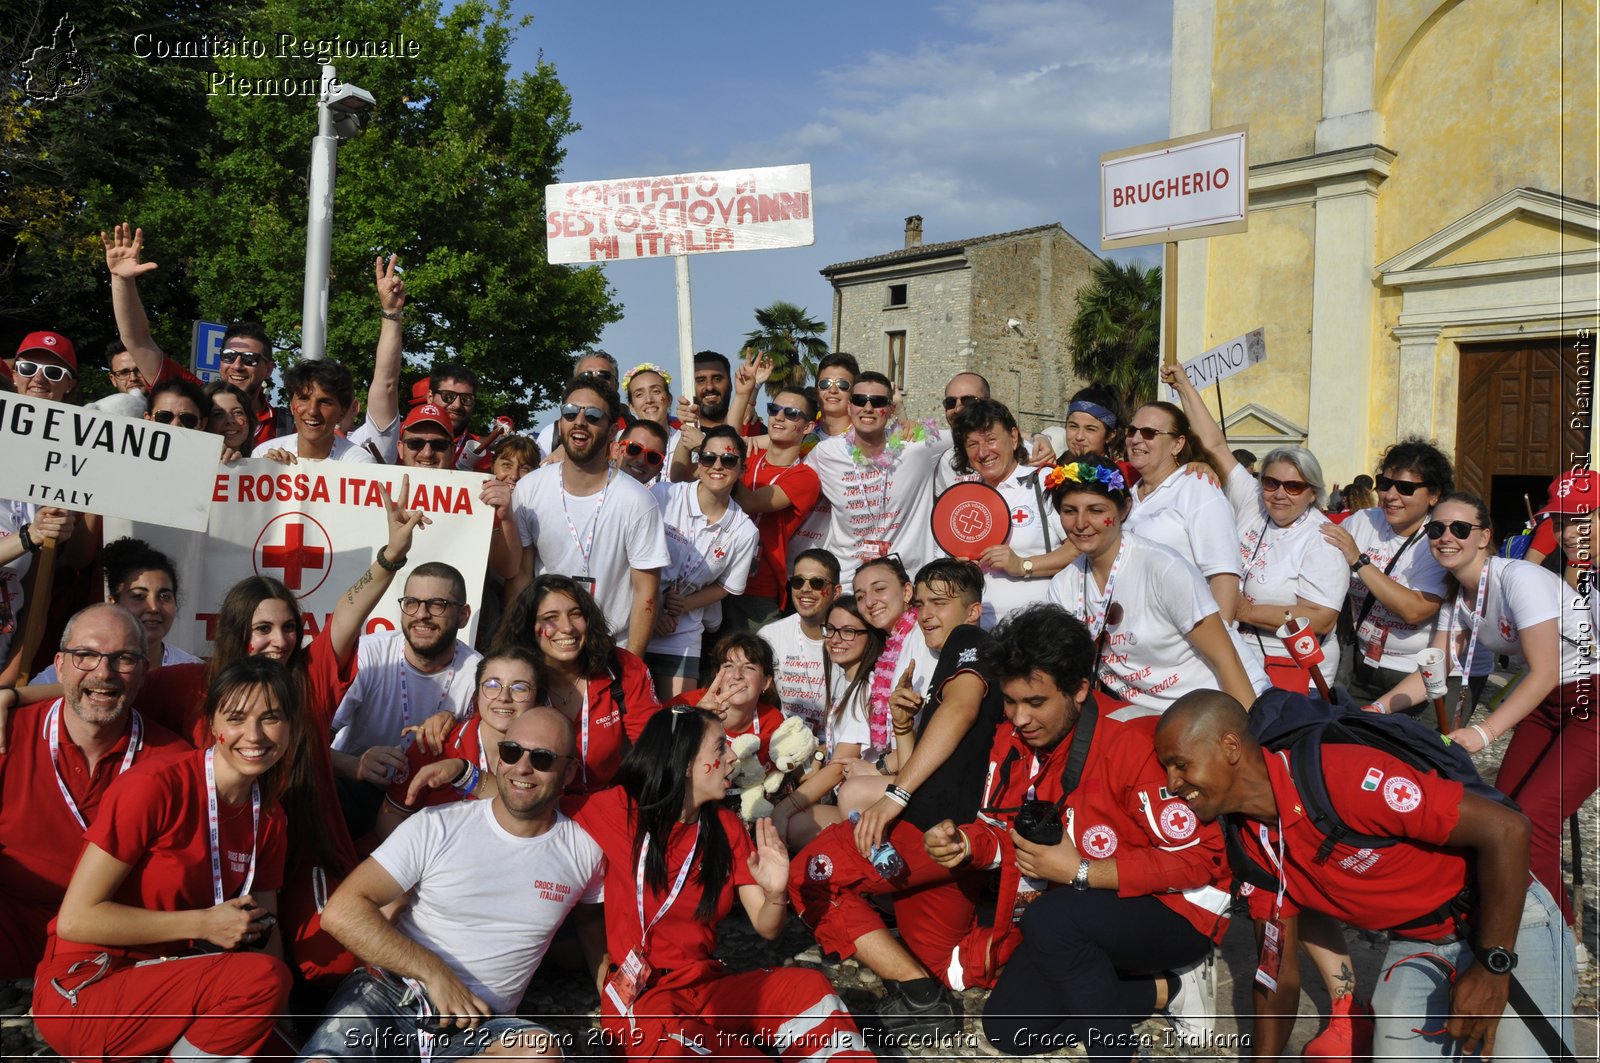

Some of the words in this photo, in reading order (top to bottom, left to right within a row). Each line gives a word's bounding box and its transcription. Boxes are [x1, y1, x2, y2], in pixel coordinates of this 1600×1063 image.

[566, 175, 719, 206] COMITATO
[1113, 167, 1230, 208] BRUGHERIO
[589, 235, 620, 260] MI
[636, 227, 735, 256] ITALIA
[28, 484, 94, 506] ITALY
[238, 474, 331, 504] ROSSA
[534, 880, 554, 891] CROCE
[555, 883, 571, 895] ROSSA
[540, 891, 565, 902] ITALIANA
